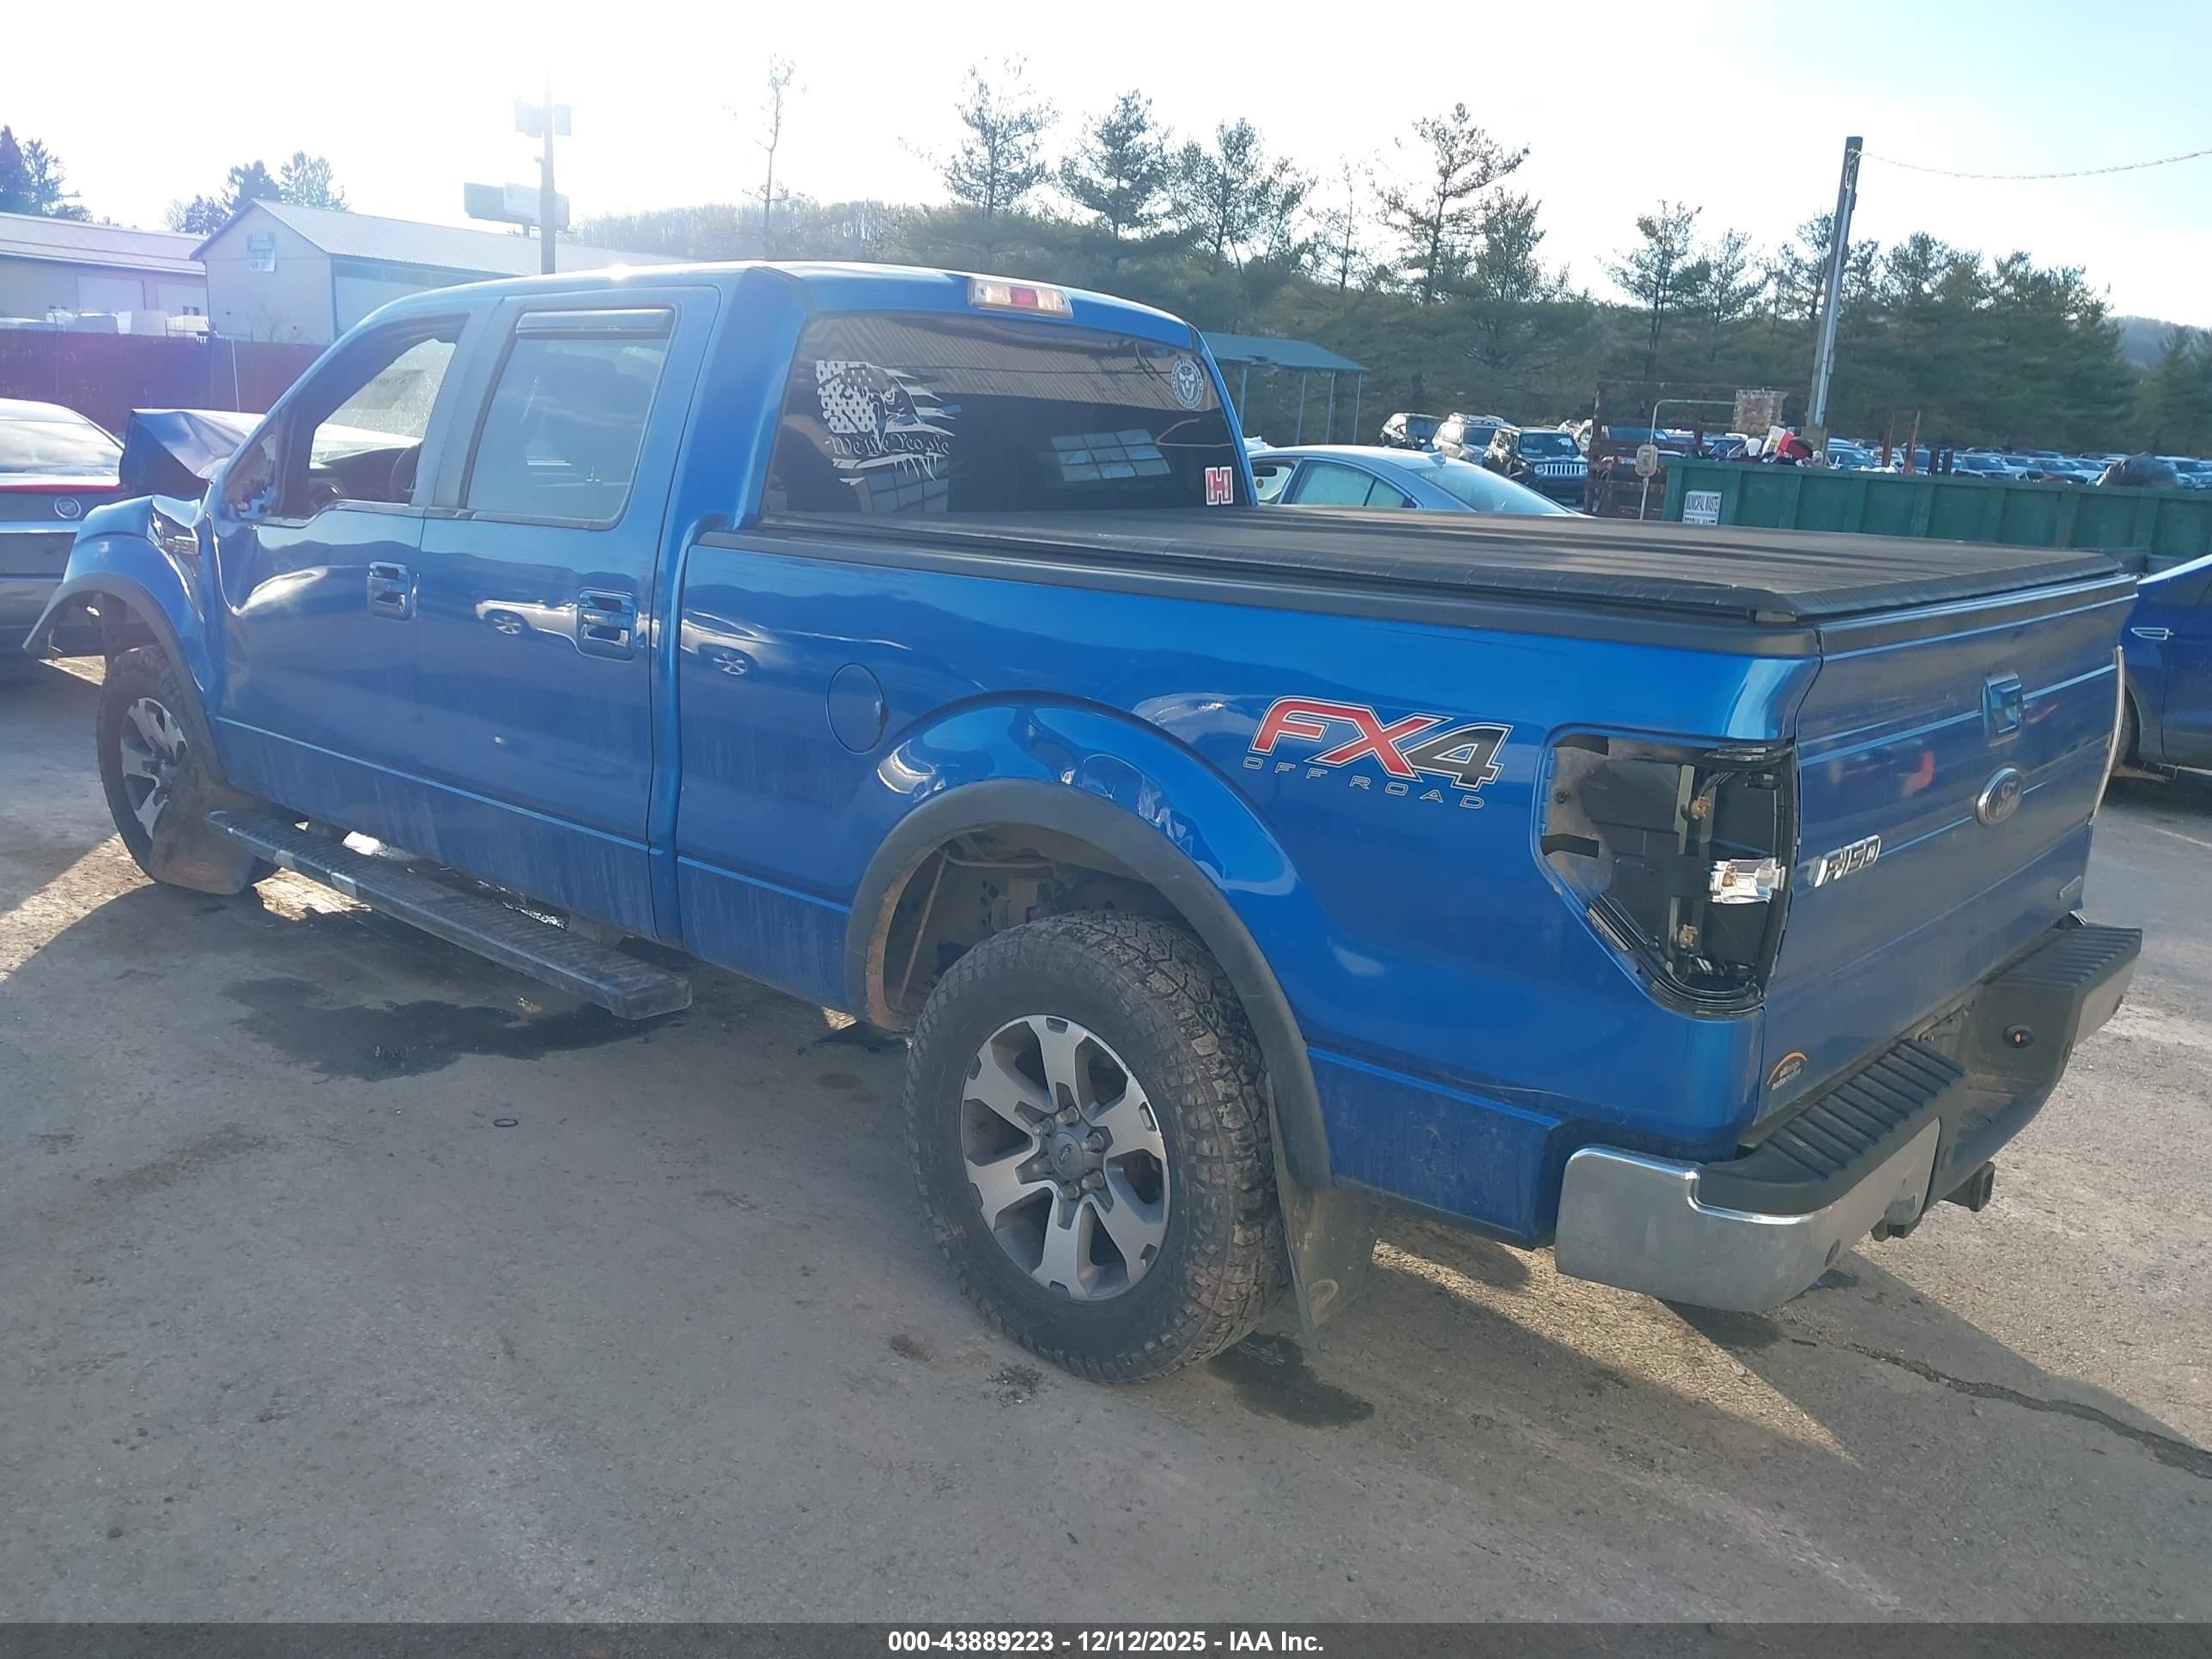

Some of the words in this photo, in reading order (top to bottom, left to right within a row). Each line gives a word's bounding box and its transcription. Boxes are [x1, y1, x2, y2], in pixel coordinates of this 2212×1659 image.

[825, 434, 863, 455] We
[890, 432, 950, 456] People
[1205, 466, 1234, 506] H
[1248, 696, 1514, 792] FX4
[1243, 757, 1328, 780] OFF
[1349, 775, 1485, 809] ROAD
